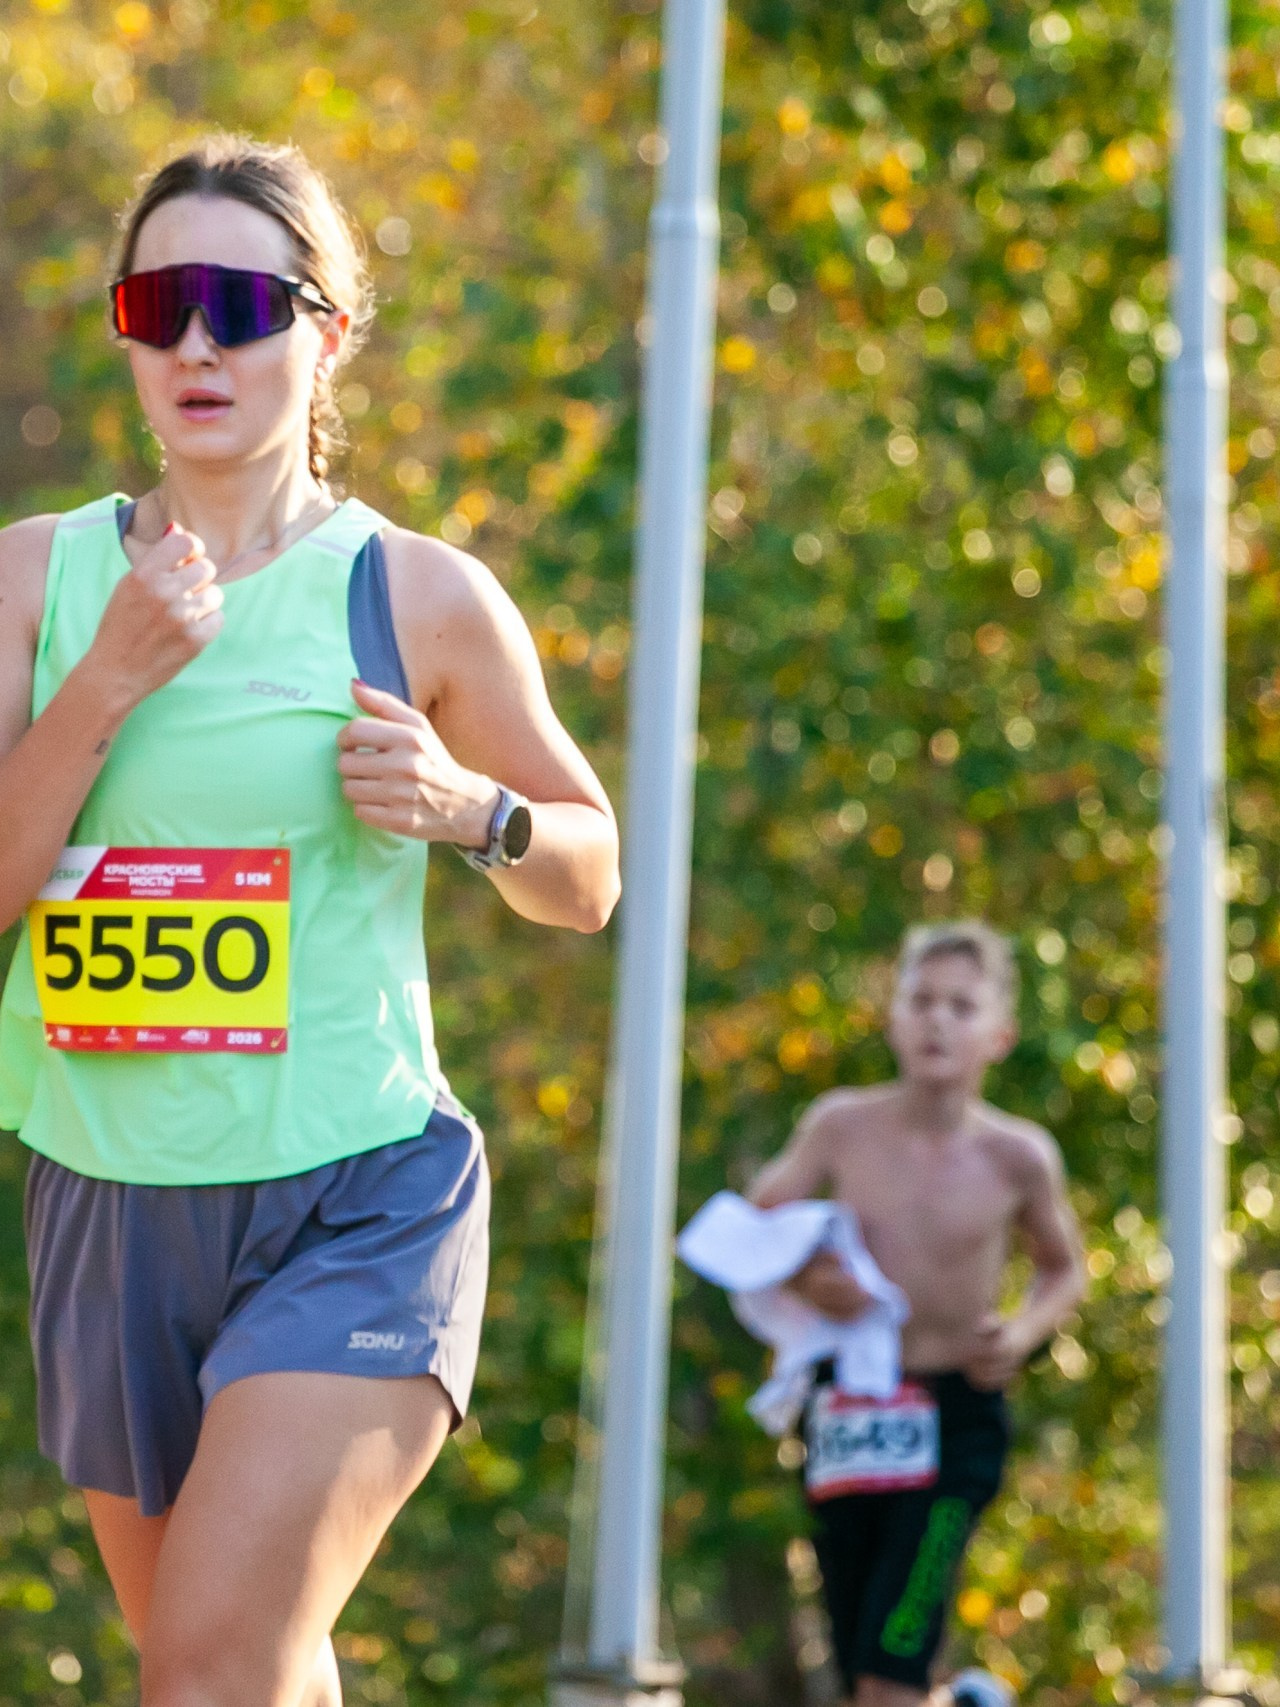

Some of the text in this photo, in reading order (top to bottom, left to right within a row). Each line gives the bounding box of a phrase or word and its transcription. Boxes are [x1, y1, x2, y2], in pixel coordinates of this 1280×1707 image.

[103, 864, 203, 876] КРАСНОЯРСКИЕ
[129, 876, 176, 887] МОСТЫ
[235, 872, 245, 885] 5
[45, 914, 271, 993] 5550
[227, 1031, 263, 1044] 2026
